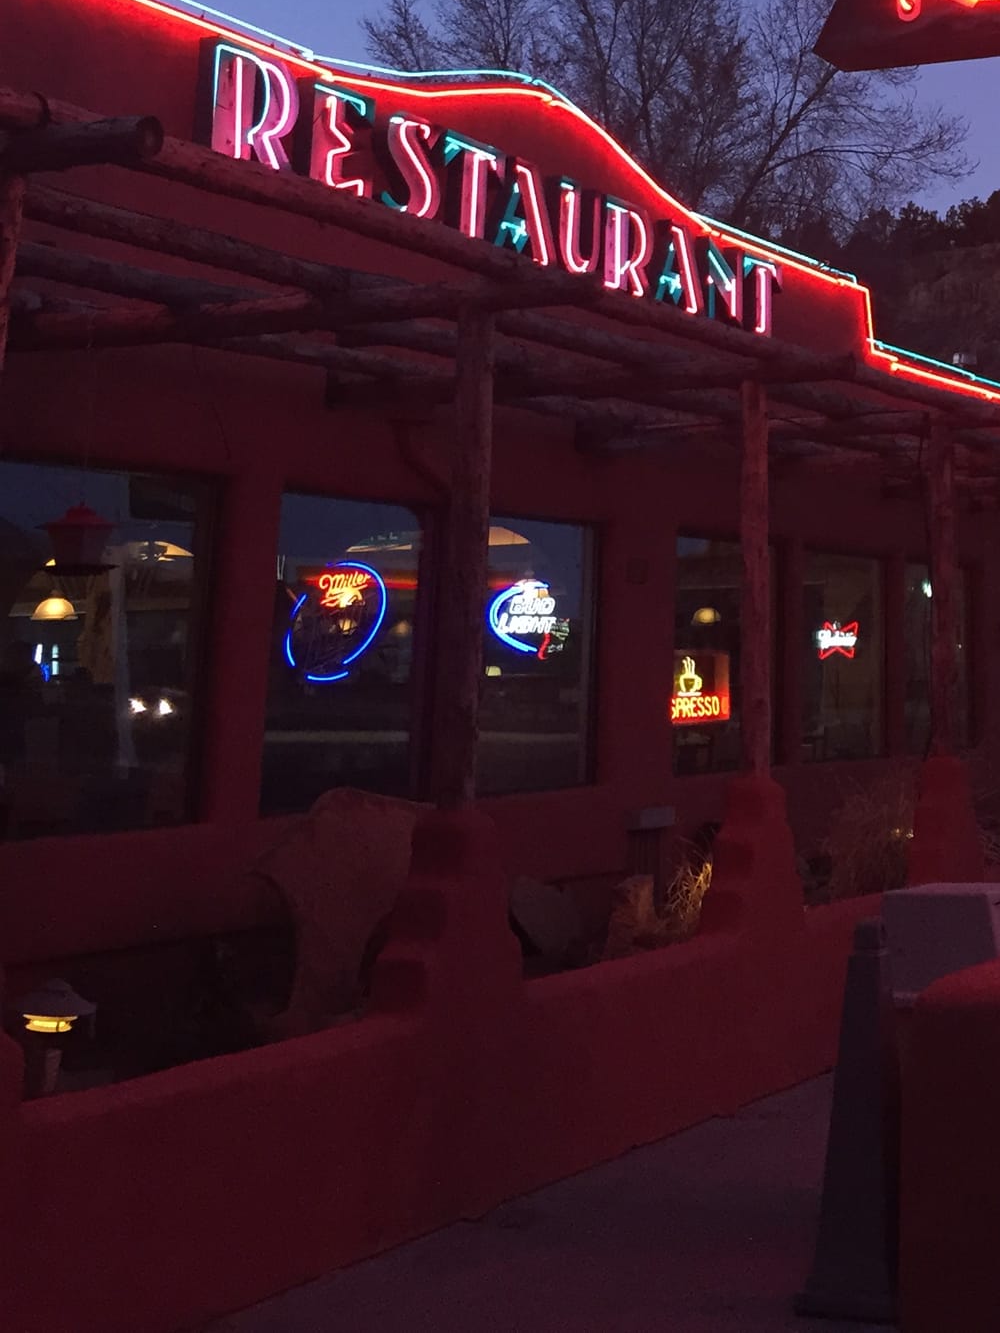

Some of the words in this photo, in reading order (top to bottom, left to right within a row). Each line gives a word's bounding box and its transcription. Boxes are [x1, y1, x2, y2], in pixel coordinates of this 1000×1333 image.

[212, 41, 784, 340] RESTAURANT
[318, 570, 372, 598] Miller
[671, 695, 720, 719] SPRESSO
